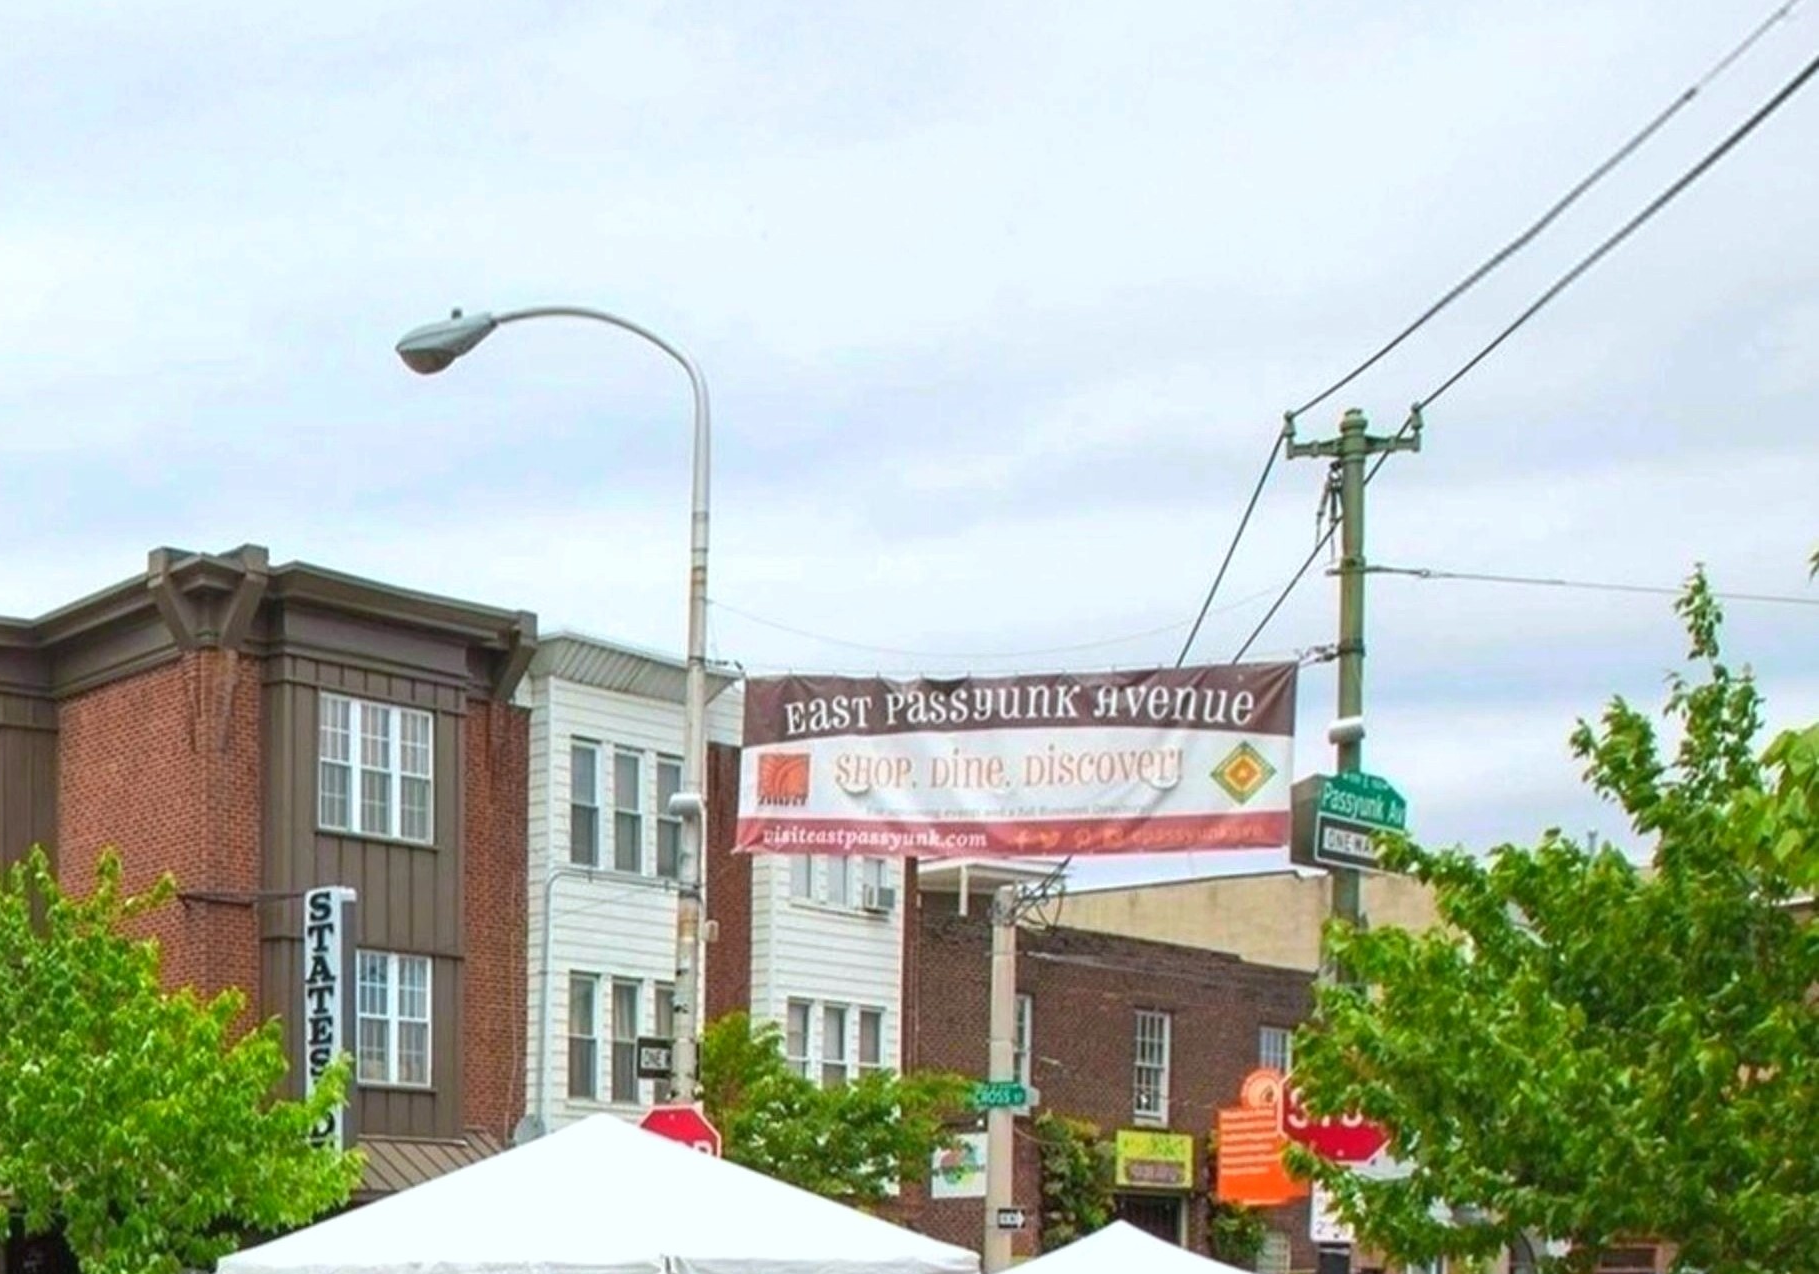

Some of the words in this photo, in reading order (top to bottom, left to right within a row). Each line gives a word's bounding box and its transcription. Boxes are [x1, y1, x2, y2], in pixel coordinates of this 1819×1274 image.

[784, 694, 873, 736] East
[885, 684, 1081, 726] Passyunk
[1093, 684, 1256, 726] Avenue
[1323, 781, 1385, 821] Passyunk
[762, 824, 987, 850] visiteastpassyunk.com
